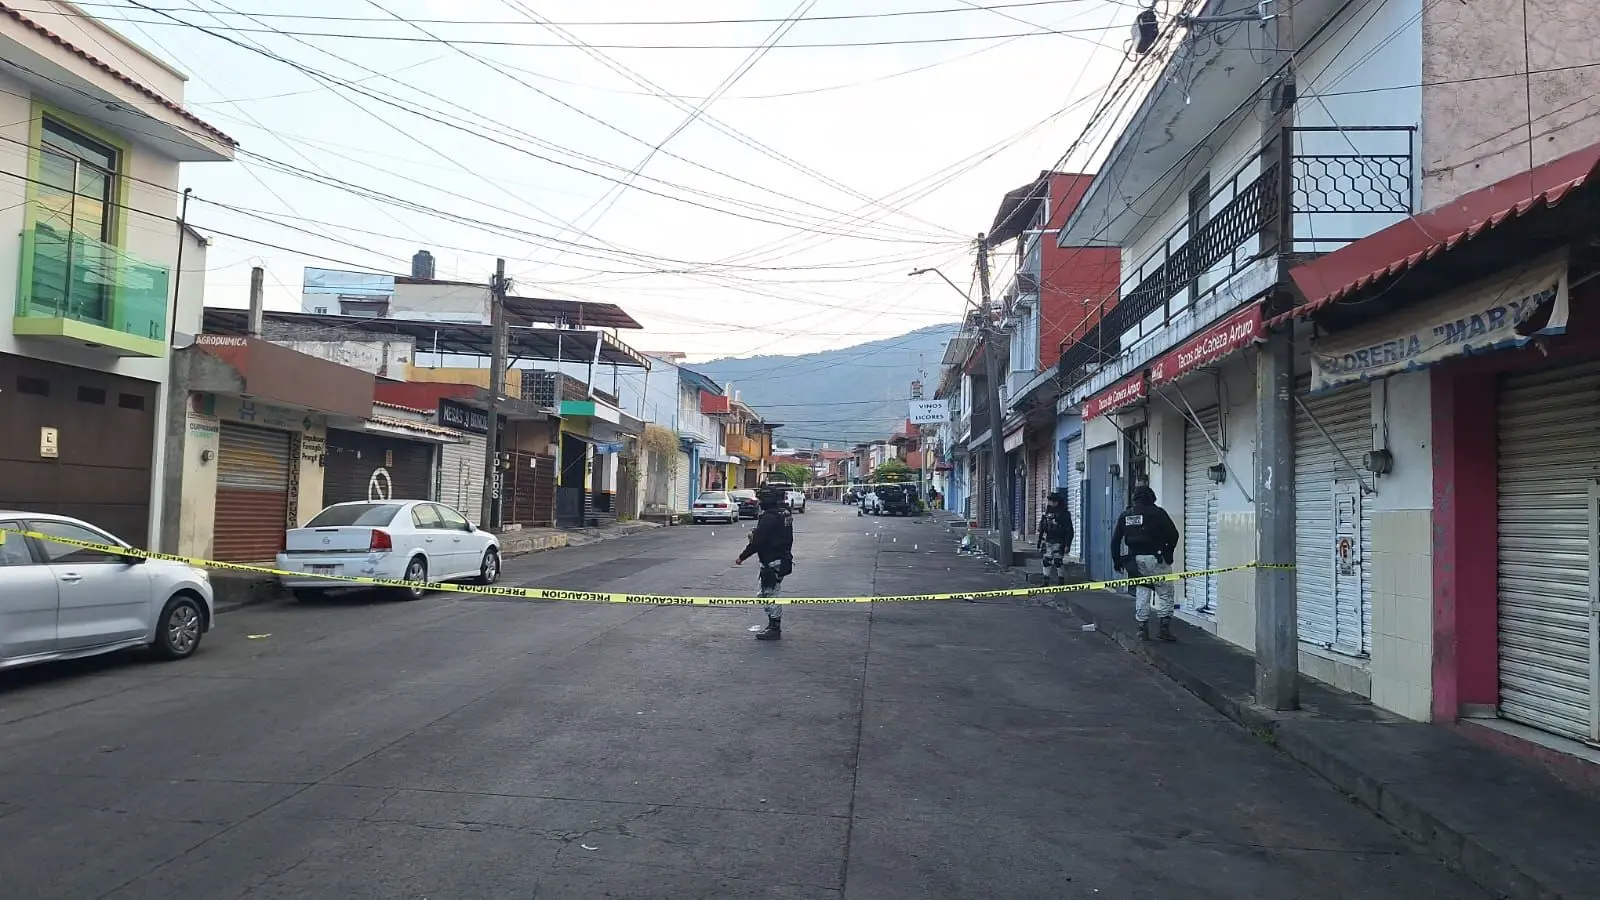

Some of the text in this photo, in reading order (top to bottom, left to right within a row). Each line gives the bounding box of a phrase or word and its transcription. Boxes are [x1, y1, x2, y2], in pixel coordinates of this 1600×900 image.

[196, 335, 248, 346] AGROQUIMICA
[1178, 319, 1253, 369] Tacos de Cabeza Arturo
[444, 404, 463, 424] MESAS
[492, 451, 501, 499] TOLDOS
[457, 585, 526, 596] PRECAUCION
[542, 591, 610, 601] PRECAUCION
[626, 596, 694, 604] PRECAUCION
